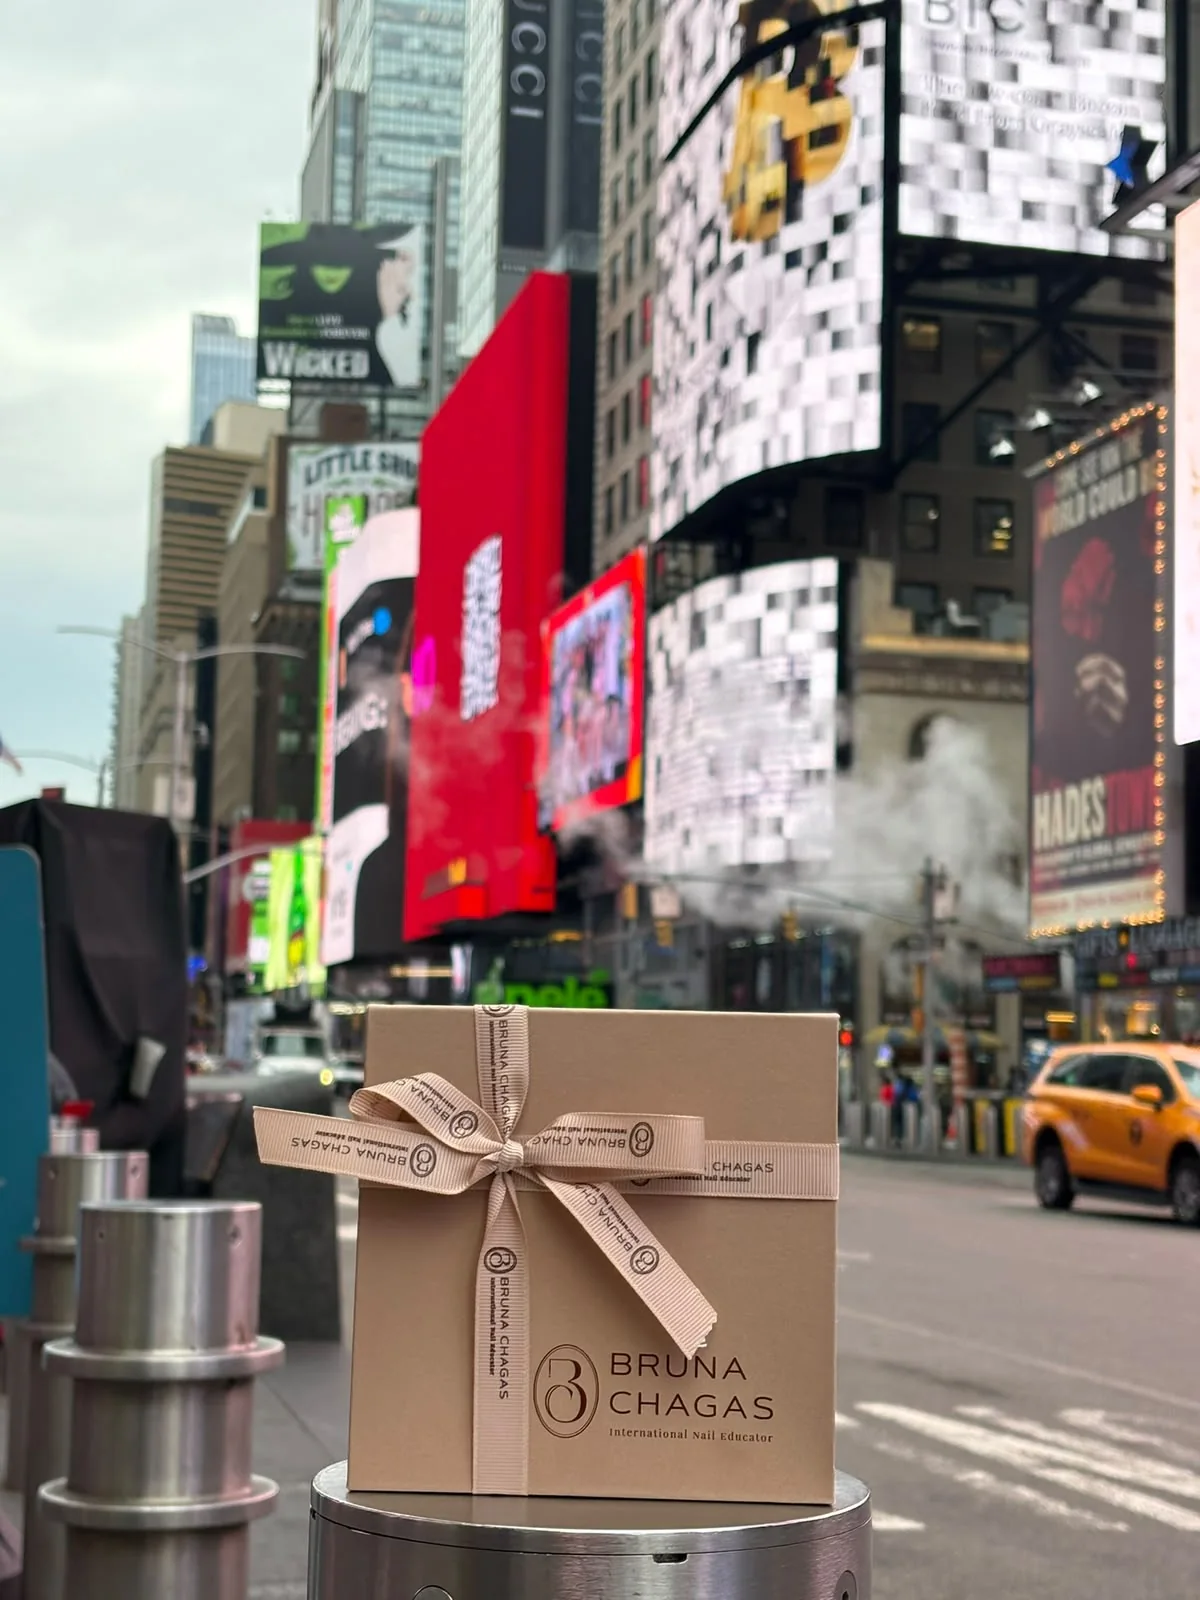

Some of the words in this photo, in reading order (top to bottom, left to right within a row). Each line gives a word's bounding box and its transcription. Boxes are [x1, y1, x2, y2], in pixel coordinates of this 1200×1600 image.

[305, 449, 371, 485] LITTLE
[498, 1020, 509, 1070] BRUNA
[411, 1085, 450, 1121] BRUNA
[291, 1137, 350, 1155] CHAGAS
[363, 1138, 409, 1153] International
[577, 1136, 626, 1148] BRUNA
[357, 1148, 407, 1166] BRUNA
[711, 1161, 774, 1173] CHAGAS
[598, 1209, 633, 1252] BRUNA
[499, 1277, 510, 1329] BRUNA
[499, 1335, 510, 1400] CHAGAS
[610, 1352, 747, 1380] BRUNA
[609, 1391, 774, 1420] CHAGAS
[609, 1427, 688, 1440] International
[692, 1431, 715, 1441] Nail
[720, 1432, 774, 1443] Educator
